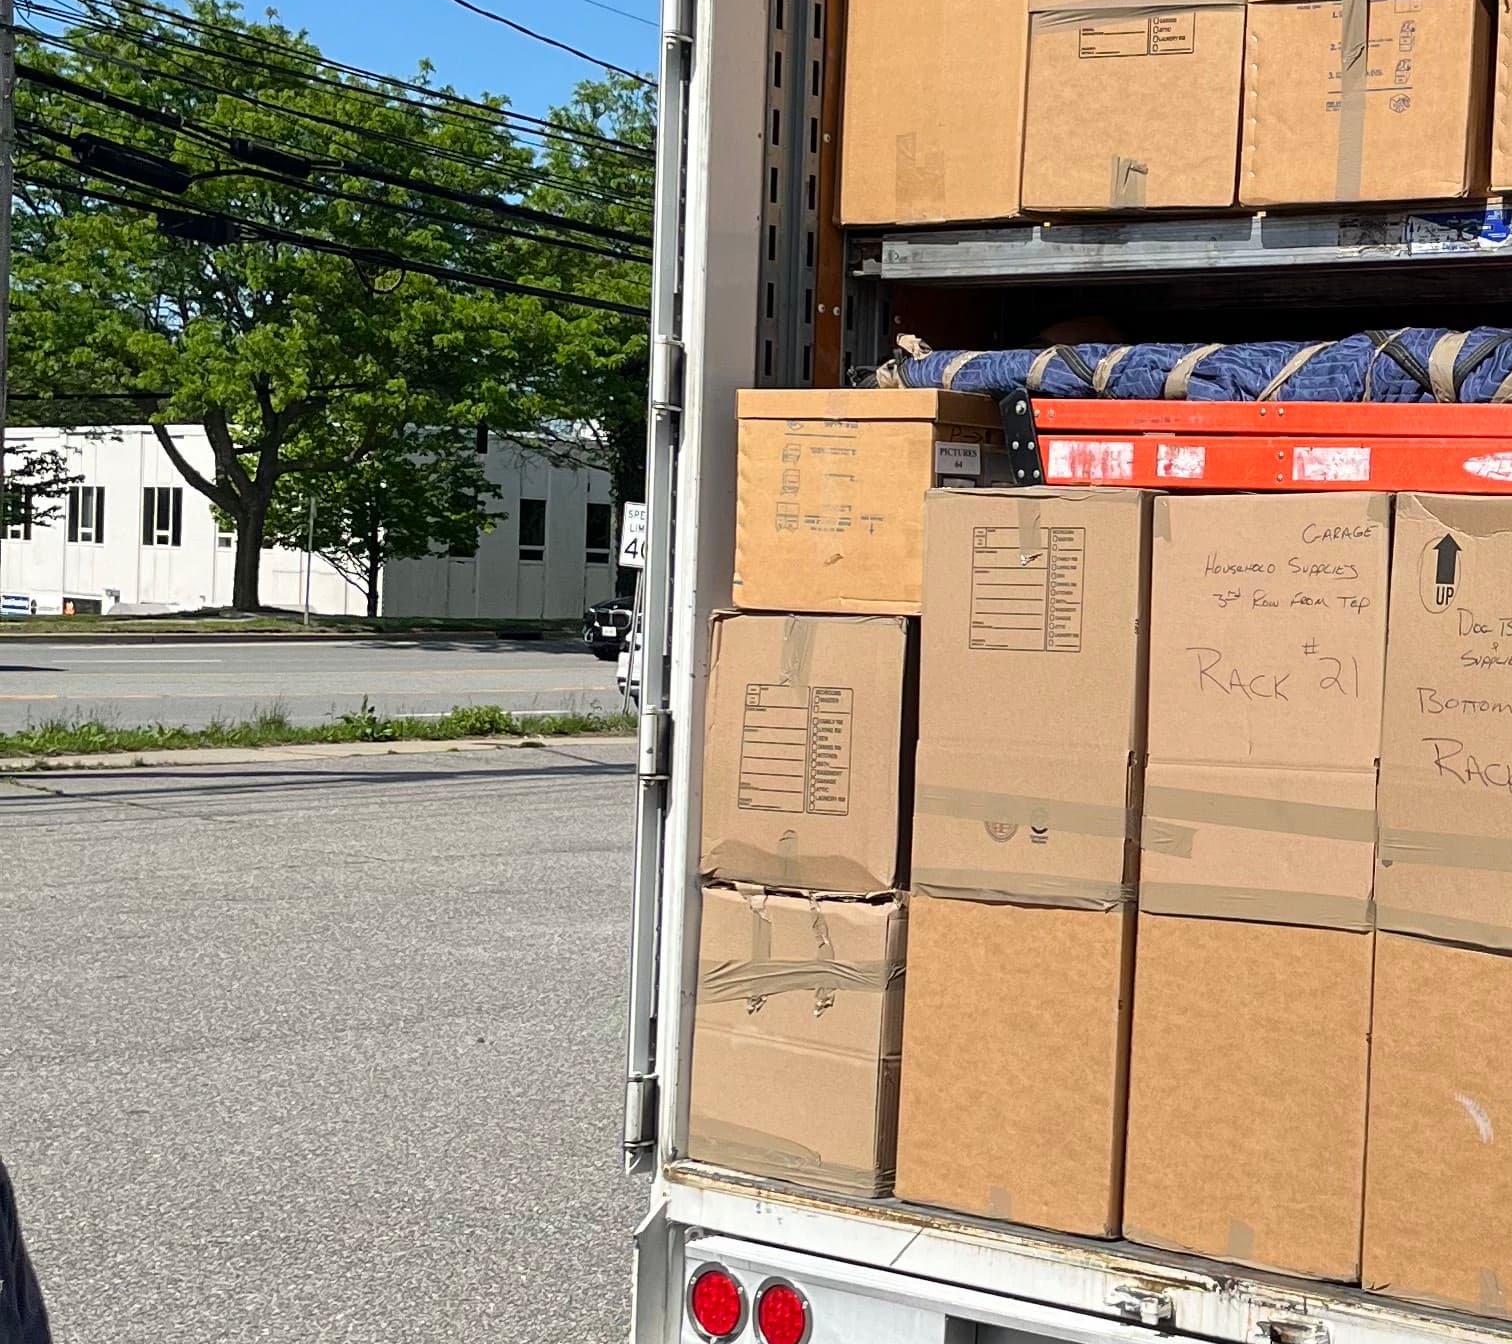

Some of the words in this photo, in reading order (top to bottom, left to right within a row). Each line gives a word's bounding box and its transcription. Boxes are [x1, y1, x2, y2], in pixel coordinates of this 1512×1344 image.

[940, 447, 978, 458] PICTURES
[1302, 523, 1379, 544] GARAGE
[1287, 557, 1359, 580] SUPPLIES
[1436, 586, 1455, 606] UP
[1185, 647, 1290, 702] RACK
